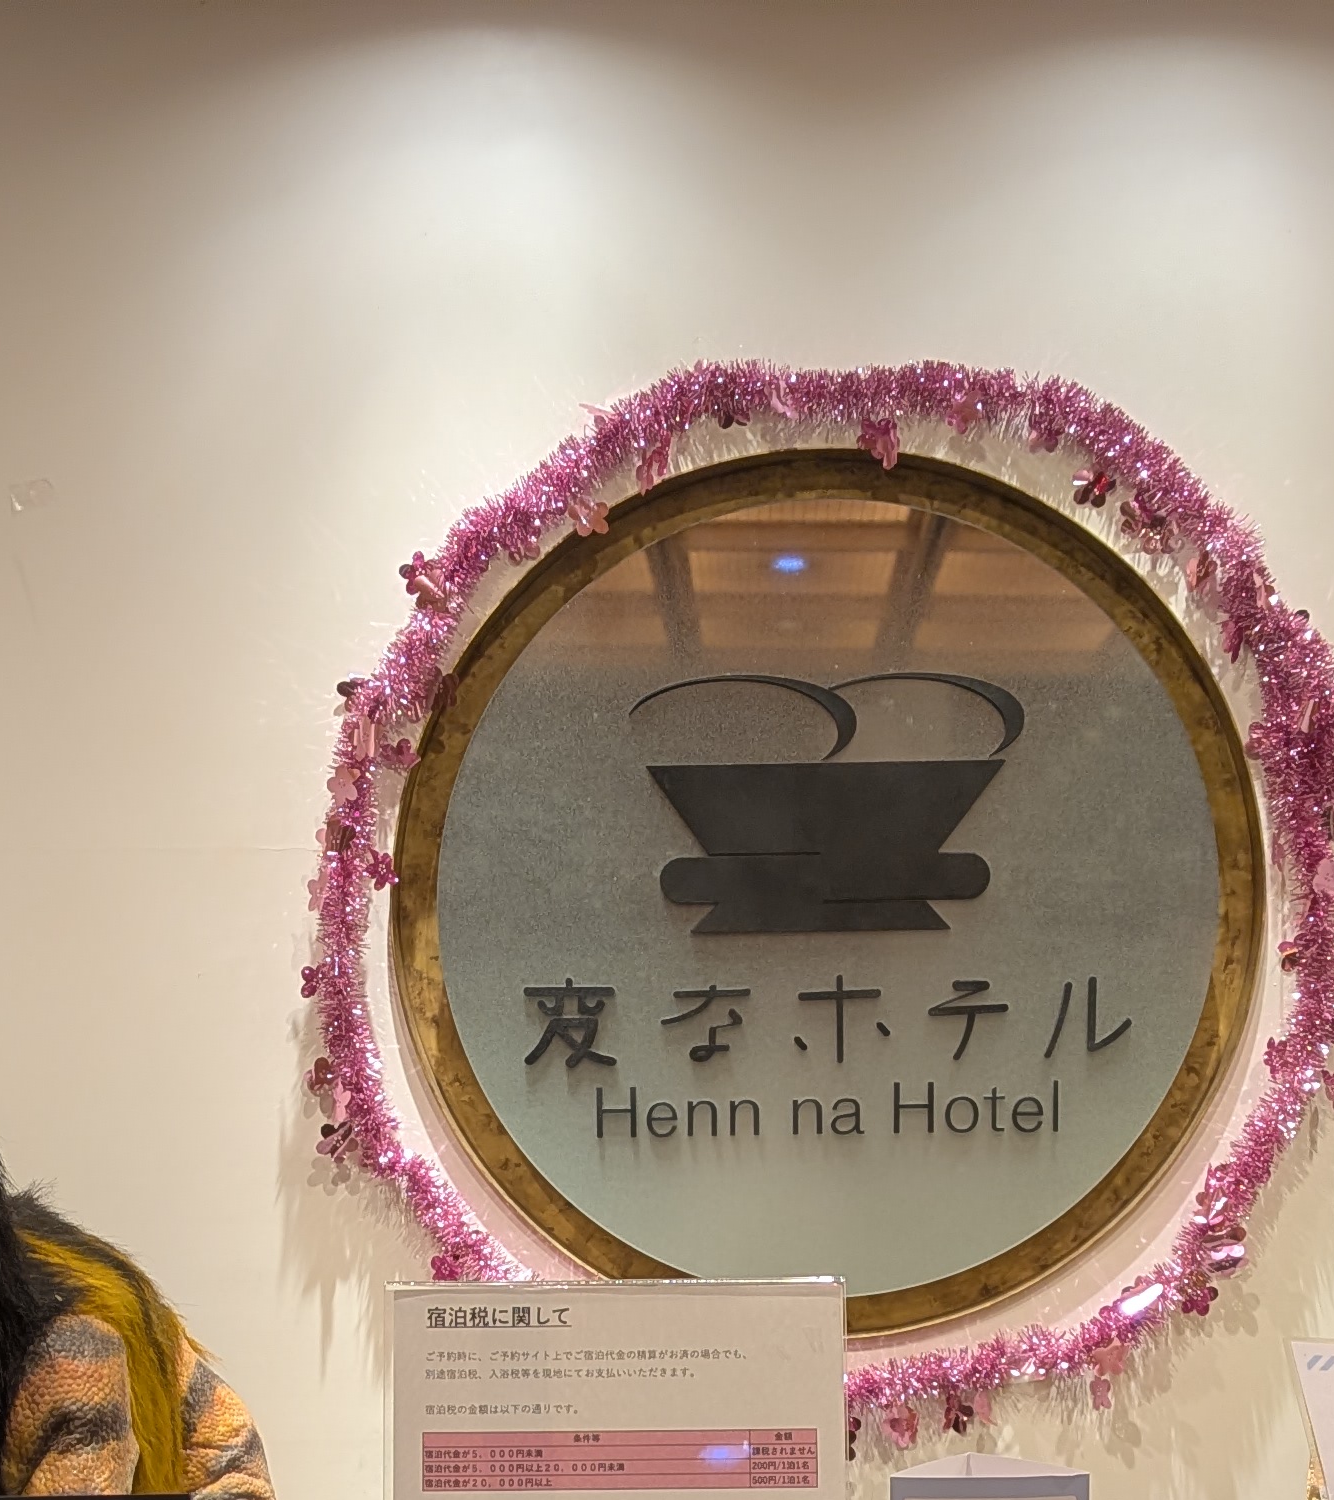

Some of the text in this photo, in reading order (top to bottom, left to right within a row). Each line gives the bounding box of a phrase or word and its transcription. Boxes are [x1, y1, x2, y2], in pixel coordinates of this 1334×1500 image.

[524, 975, 1132, 1067] 変なホテル
[596, 1080, 1060, 1138] Henn na Hotel
[426, 1306, 572, 1328] 宿泊税に関して
[425, 1403, 579, 1416] 宿泊税の金額は以下の通りです。
